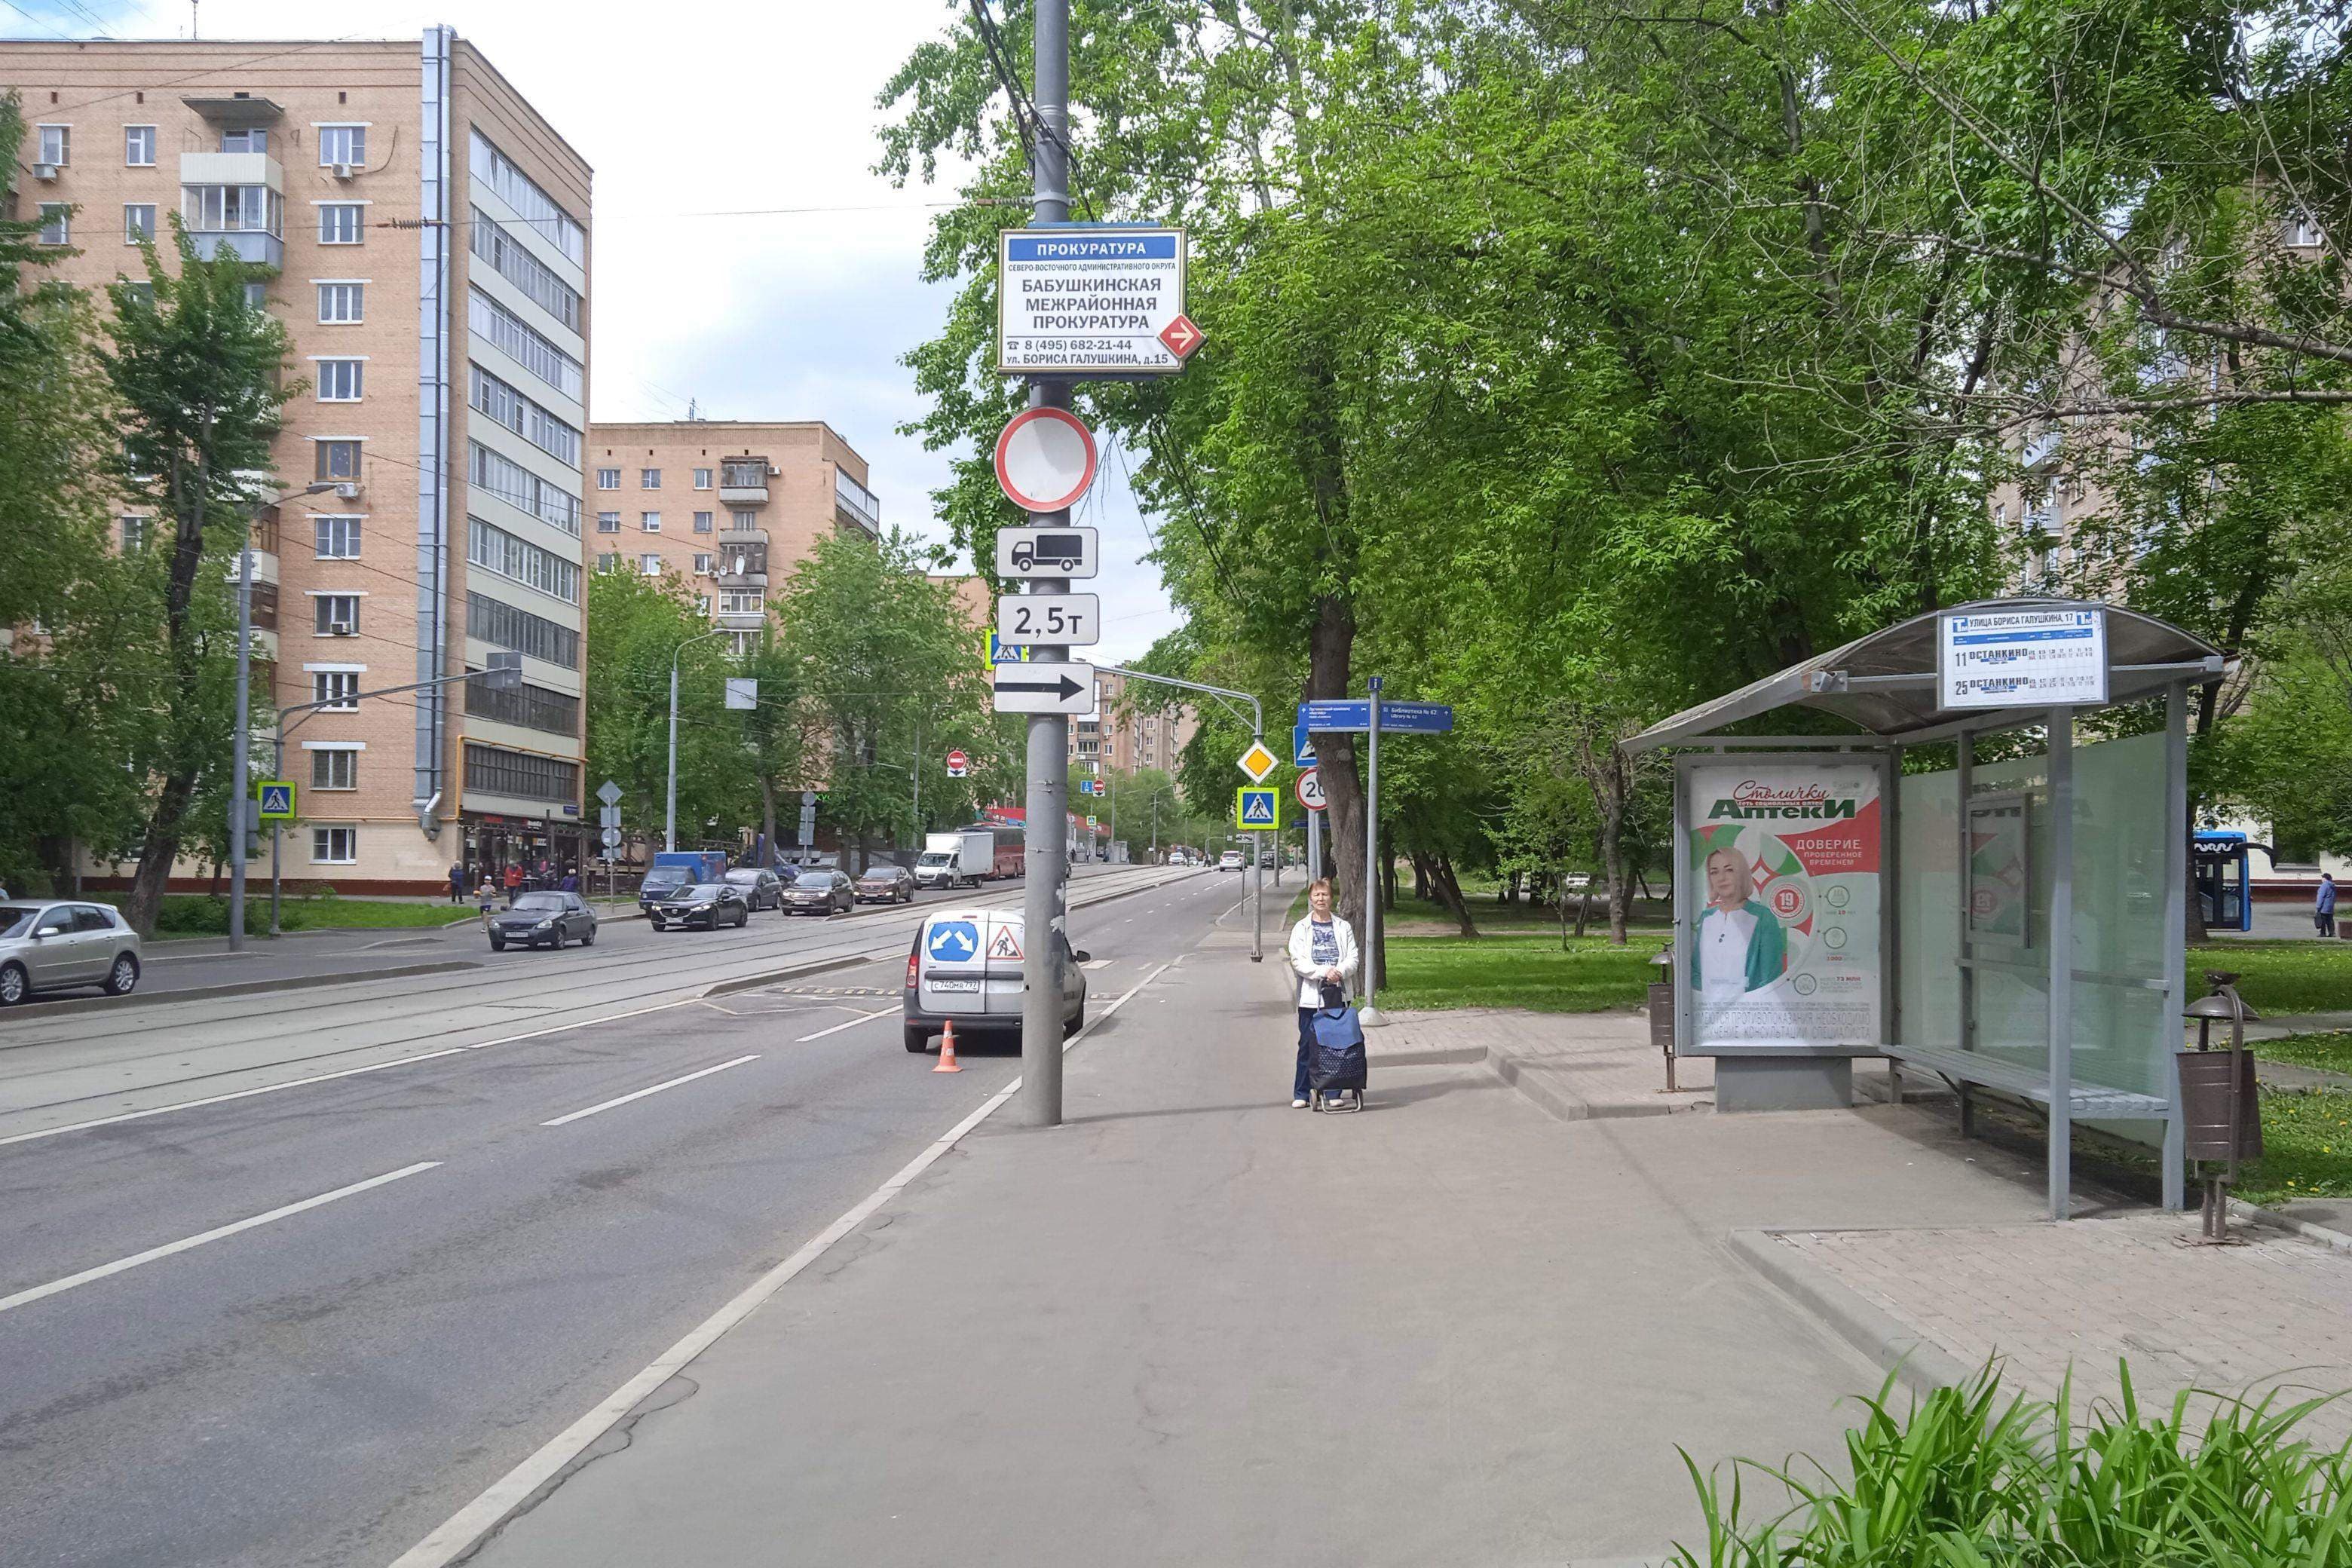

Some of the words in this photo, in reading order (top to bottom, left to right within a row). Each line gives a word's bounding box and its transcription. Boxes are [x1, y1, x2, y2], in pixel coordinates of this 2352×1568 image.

[1037, 242, 1147, 256] ПРОКУРАТУРА
[1008, 263, 1077, 272] СЕВЕРО-ВОСТОЧНОГО
[1078, 262, 1150, 272] АДМИНИСТРАТИВНОГО
[1151, 262, 1176, 271] ОКРУГА
[1022, 278, 1162, 292] БАБУШКИНСКАЯ
[1025, 295, 1157, 311] МЕЖРАЙОННАЯ
[1034, 315, 1150, 329] ПРОКУРАТУРА
[1024, 340, 1033, 350] 8
[1035, 339, 1067, 352] (495)
[1070, 339, 1132, 351] 682-21-44
[1006, 356, 1021, 365] ул.
[1023, 354, 1068, 365] БОРИСА
[1070, 354, 1141, 367] ГАЛУШКИНА,
[1969, 618, 1992, 627] УЛИЦА
[1993, 616, 2020, 626] БОРИСА
[2021, 614, 2063, 624] ГАЛУШКИНА,
[2066, 613, 2073, 621] 17
[1955, 652, 1967, 667] 11
[1969, 648, 2028, 660] ОСТАНКИНО
[1955, 680, 1968, 695] 25
[1970, 677, 2029, 688] ОСТАНКИНО
[1733, 779, 1830, 800] Столички
[1796, 839, 1862, 850] ДОВЕРИЕ
[1779, 892, 1793, 906] 19
